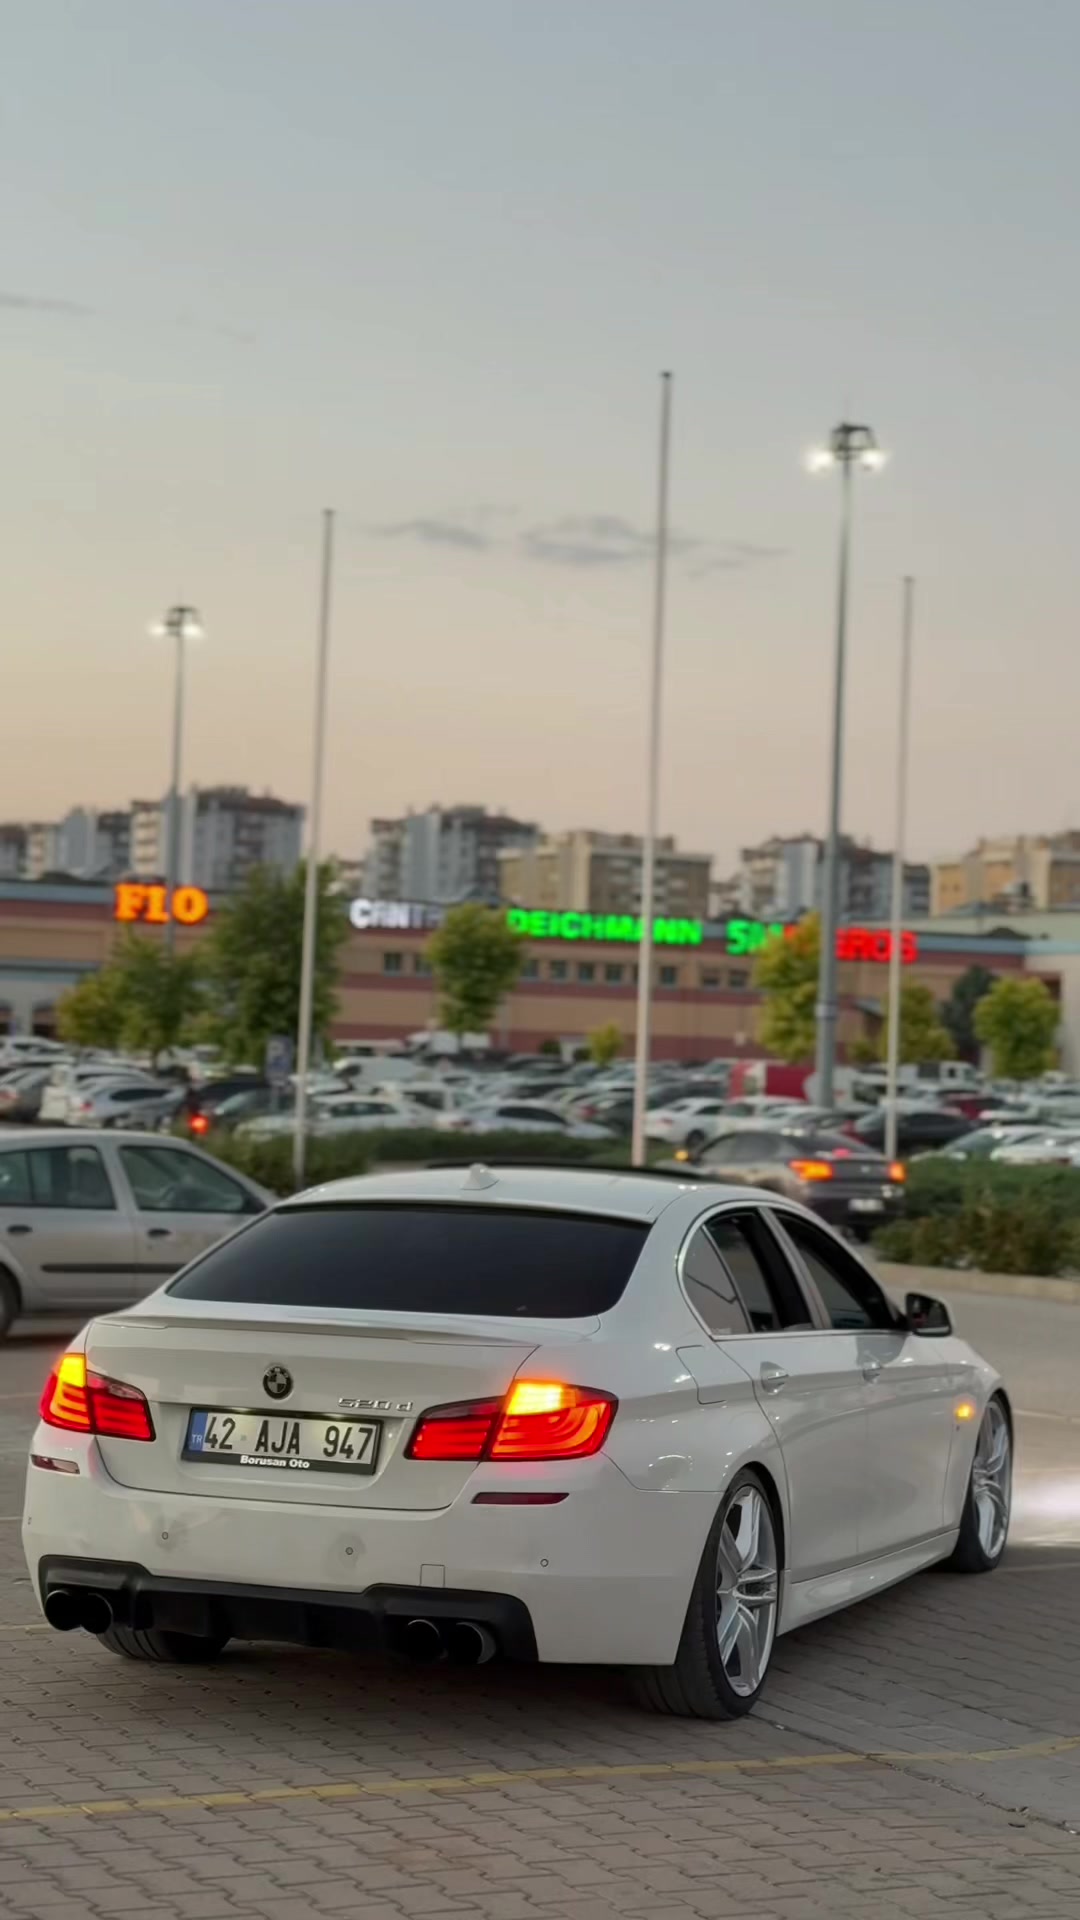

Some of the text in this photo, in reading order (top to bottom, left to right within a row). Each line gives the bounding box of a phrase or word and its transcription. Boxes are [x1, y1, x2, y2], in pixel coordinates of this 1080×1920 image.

[192, 1434, 202, 1443] TR
[204, 1416, 373, 1460] 42 AJA 947
[240, 1455, 310, 1469] Borusan Oto
